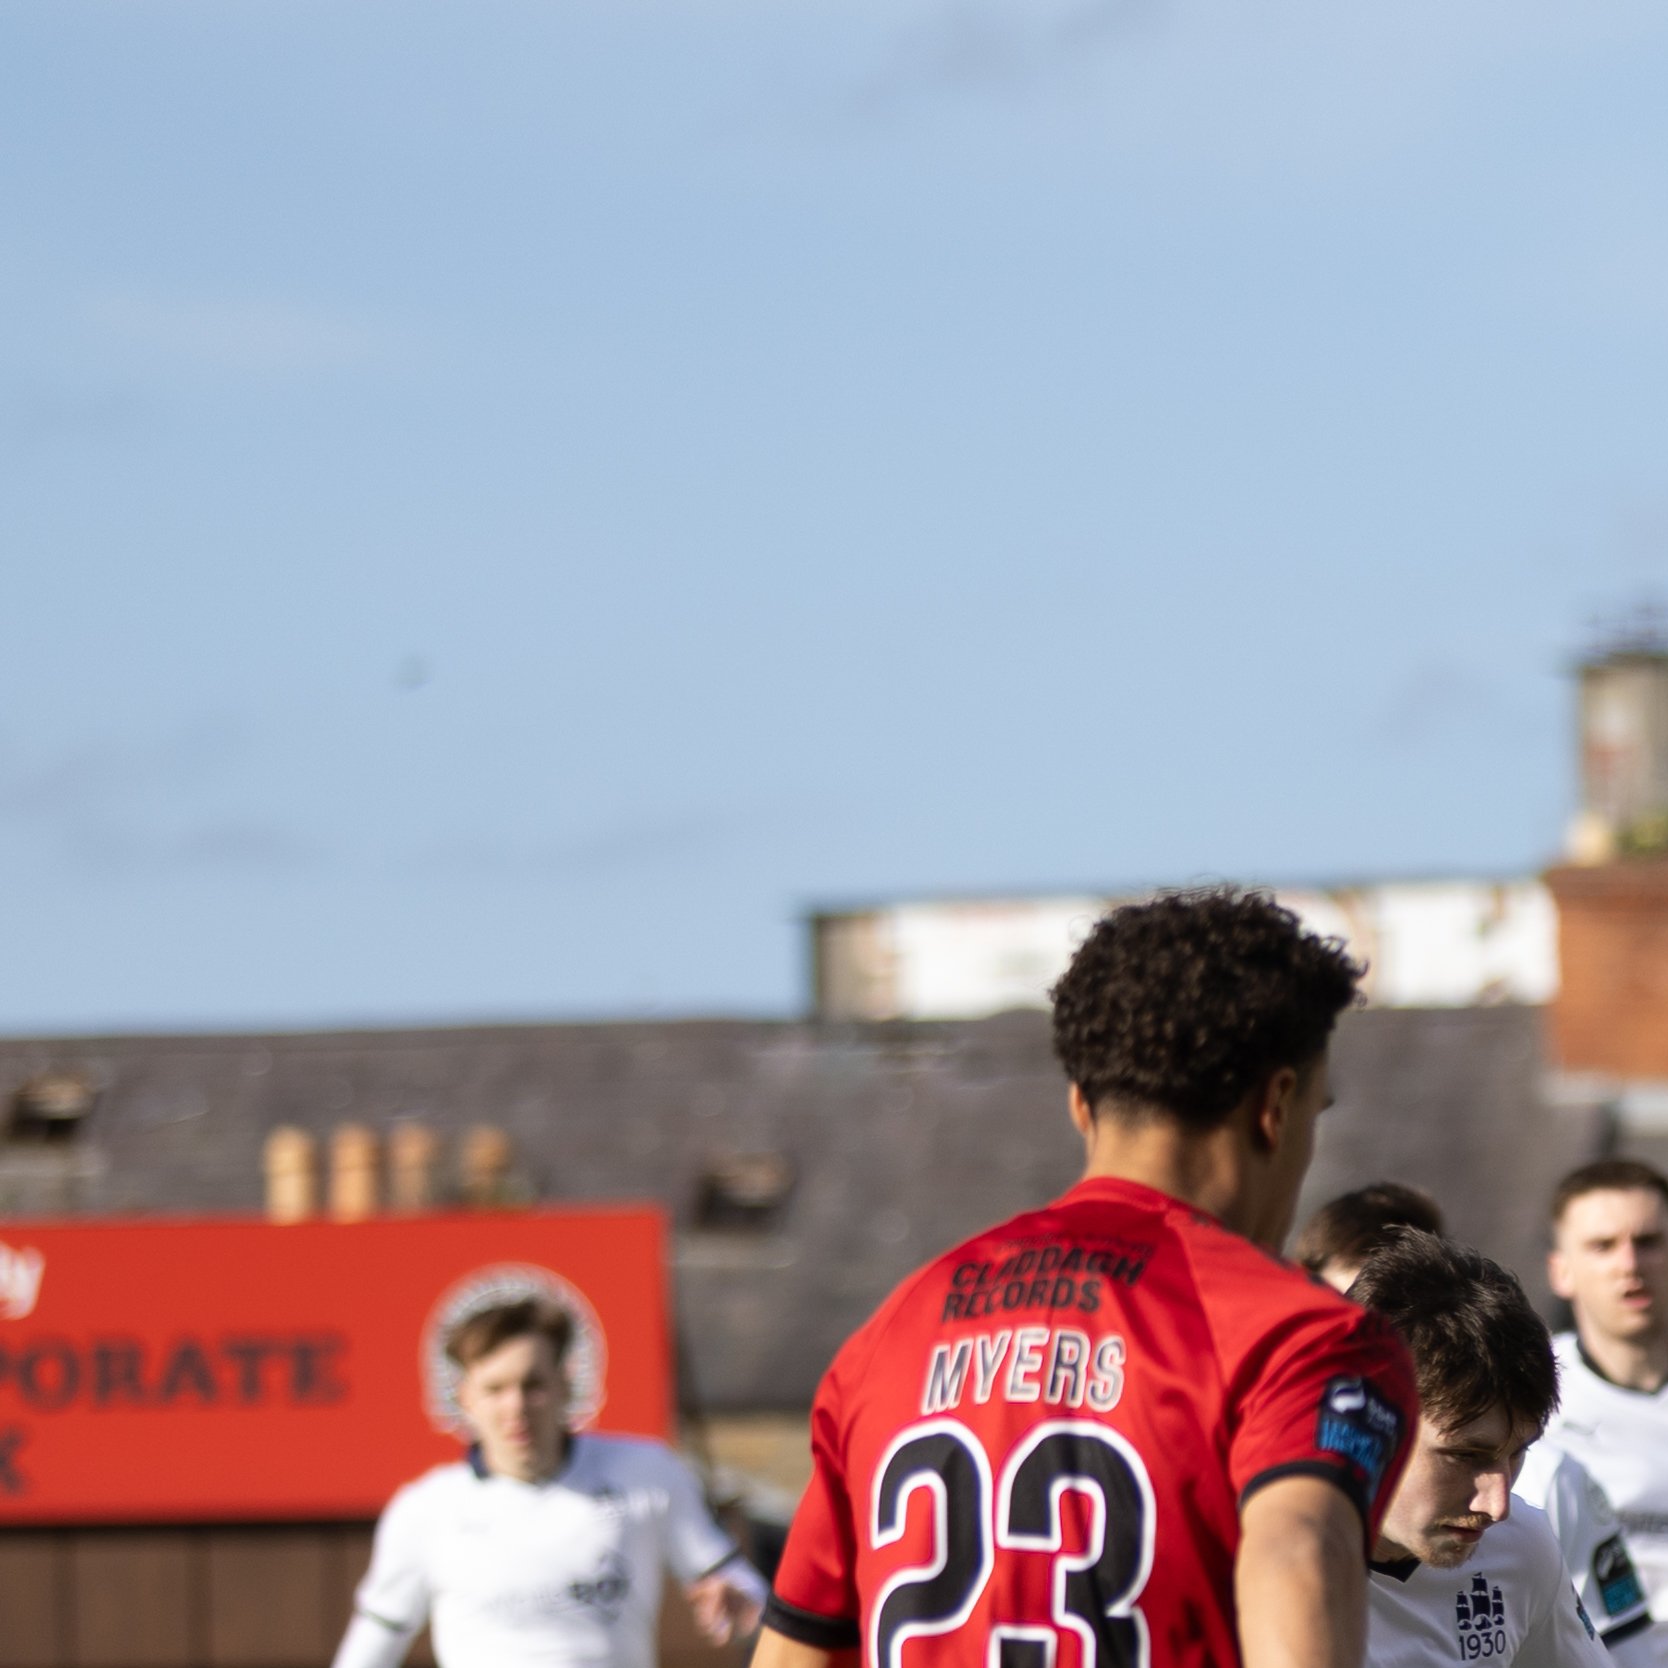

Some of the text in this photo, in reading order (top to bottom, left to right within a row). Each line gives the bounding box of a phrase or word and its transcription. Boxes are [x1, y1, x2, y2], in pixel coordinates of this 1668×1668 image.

[943, 1277, 1102, 1323] RECORDS
[921, 1325, 1126, 1415] MYERS
[1459, 1630, 1506, 1661] 1930
